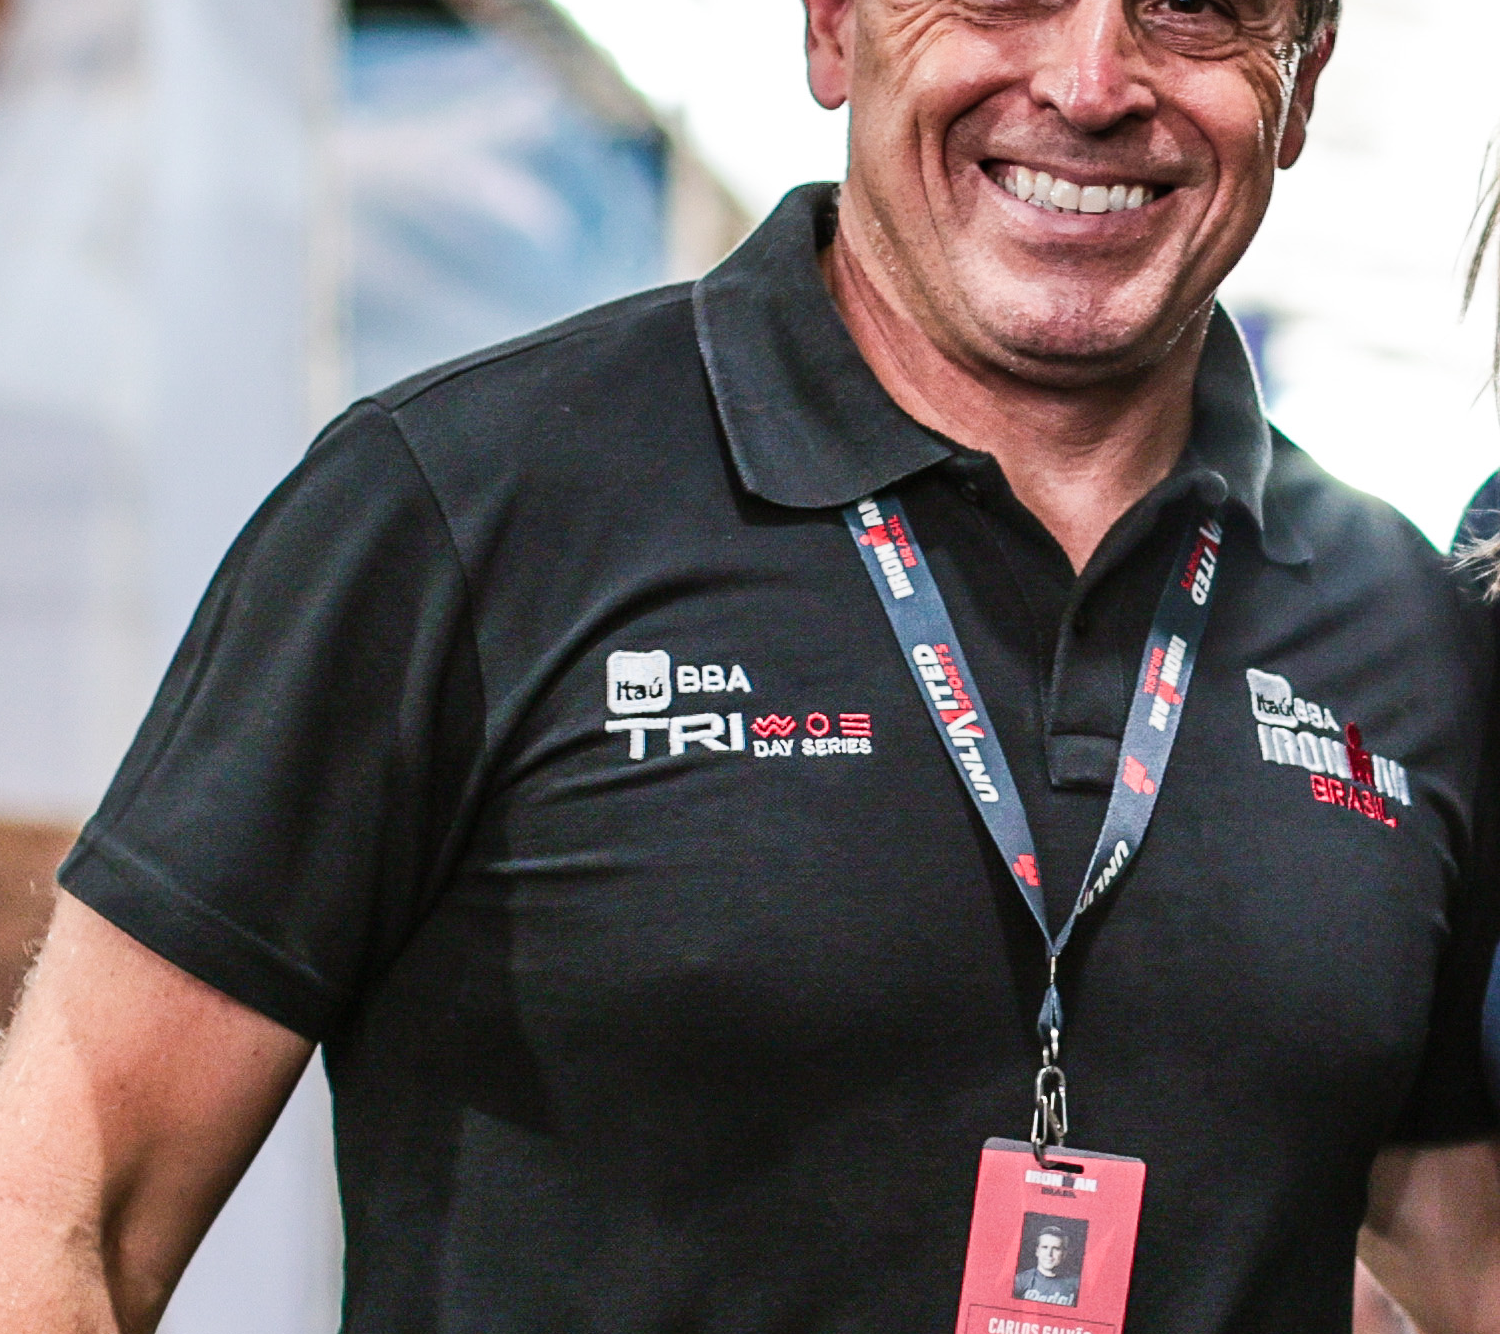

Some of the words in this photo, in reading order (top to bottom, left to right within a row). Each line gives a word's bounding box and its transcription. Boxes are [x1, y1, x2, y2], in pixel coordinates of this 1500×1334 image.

[615, 676, 664, 701] Itaú
[676, 664, 752, 693] BBA
[933, 643, 974, 710] SPORTS
[1148, 634, 1188, 732] IRONMAN
[604, 712, 746, 760] TRI
[912, 643, 999, 803] UNLIMITED
[1293, 697, 1341, 732] BBA
[752, 738, 795, 758] DAY
[801, 736, 873, 756] SERIES
[1310, 774, 1398, 829] BRASIL
